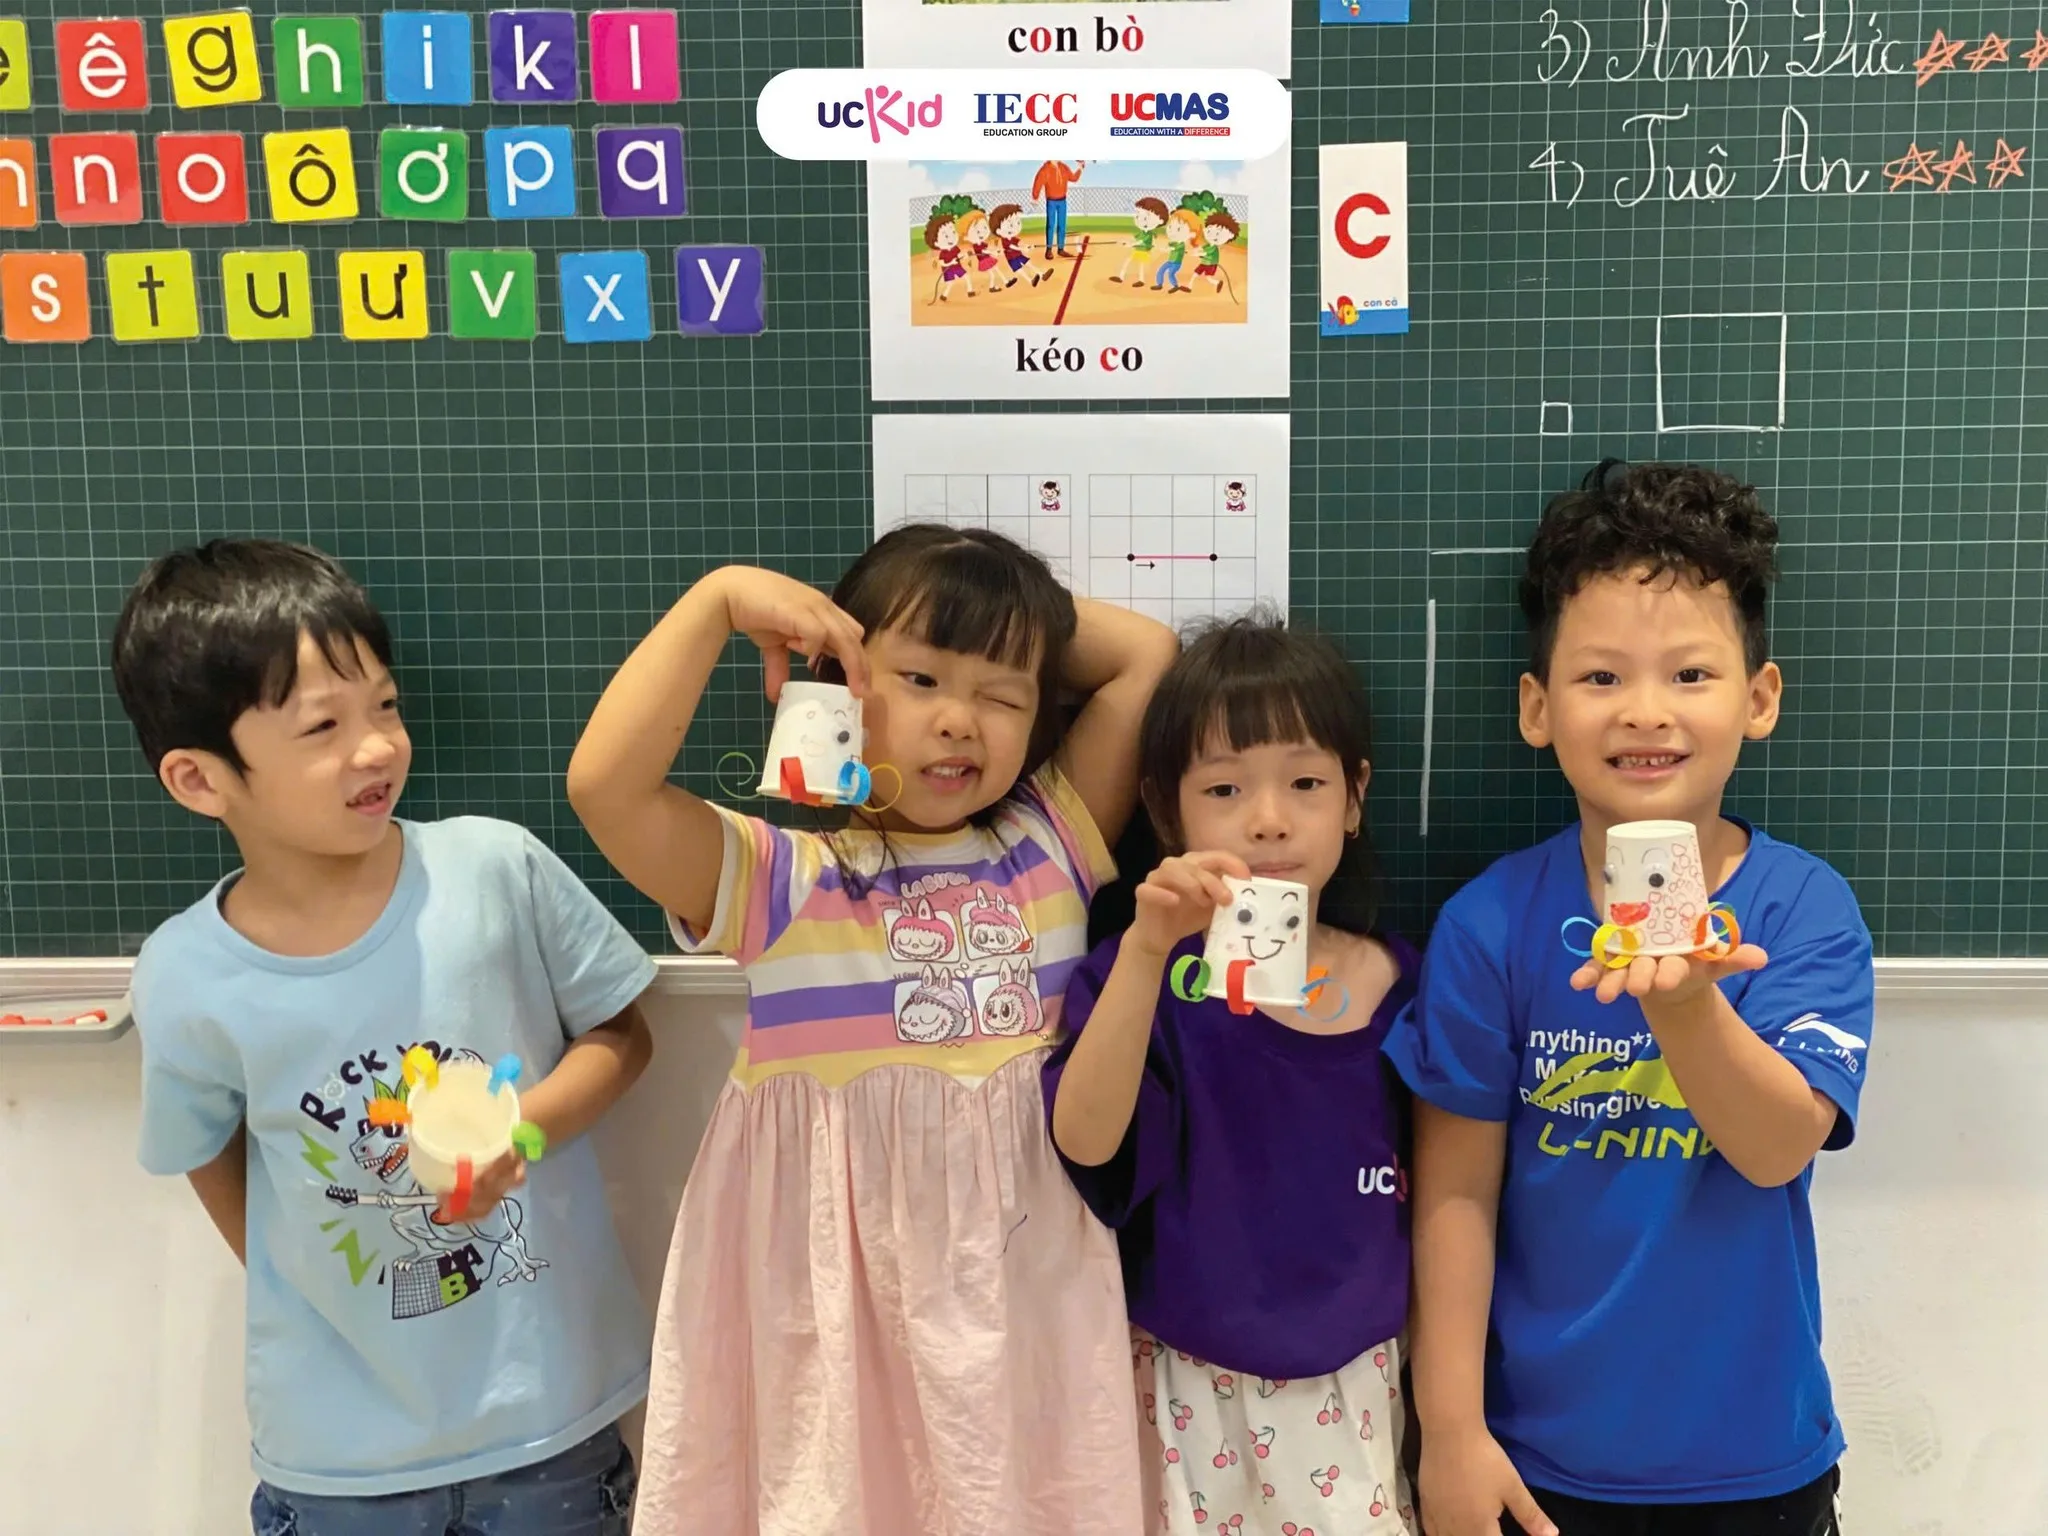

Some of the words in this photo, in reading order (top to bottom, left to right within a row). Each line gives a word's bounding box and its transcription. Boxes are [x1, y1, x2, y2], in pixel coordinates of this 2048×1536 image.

[79, 34, 126, 97] ê
[187, 26, 238, 92] g
[298, 29, 342, 92] h
[423, 25, 433, 89] i
[515, 25, 553, 90] k
[631, 25, 641, 90] l
[1008, 26, 1078, 53] con
[1096, 16, 1144, 53] bò
[74, 155, 118, 203] n
[178, 154, 226, 202] o
[289, 143, 337, 207] ô
[398, 143, 449, 203] ơ
[505, 141, 554, 206] p
[617, 140, 668, 204] q
[1754, 105, 1870, 200] An
[32, 274, 60, 322] s
[138, 265, 165, 327] t
[246, 271, 290, 319] u
[361, 264, 408, 321] ư
[471, 271, 515, 319] v
[585, 274, 624, 322] x
[697, 258, 741, 321] y
[1016, 337, 1085, 372] kéo
[1100, 348, 1143, 372] co
[1526, 1029, 1631, 1062] nything
